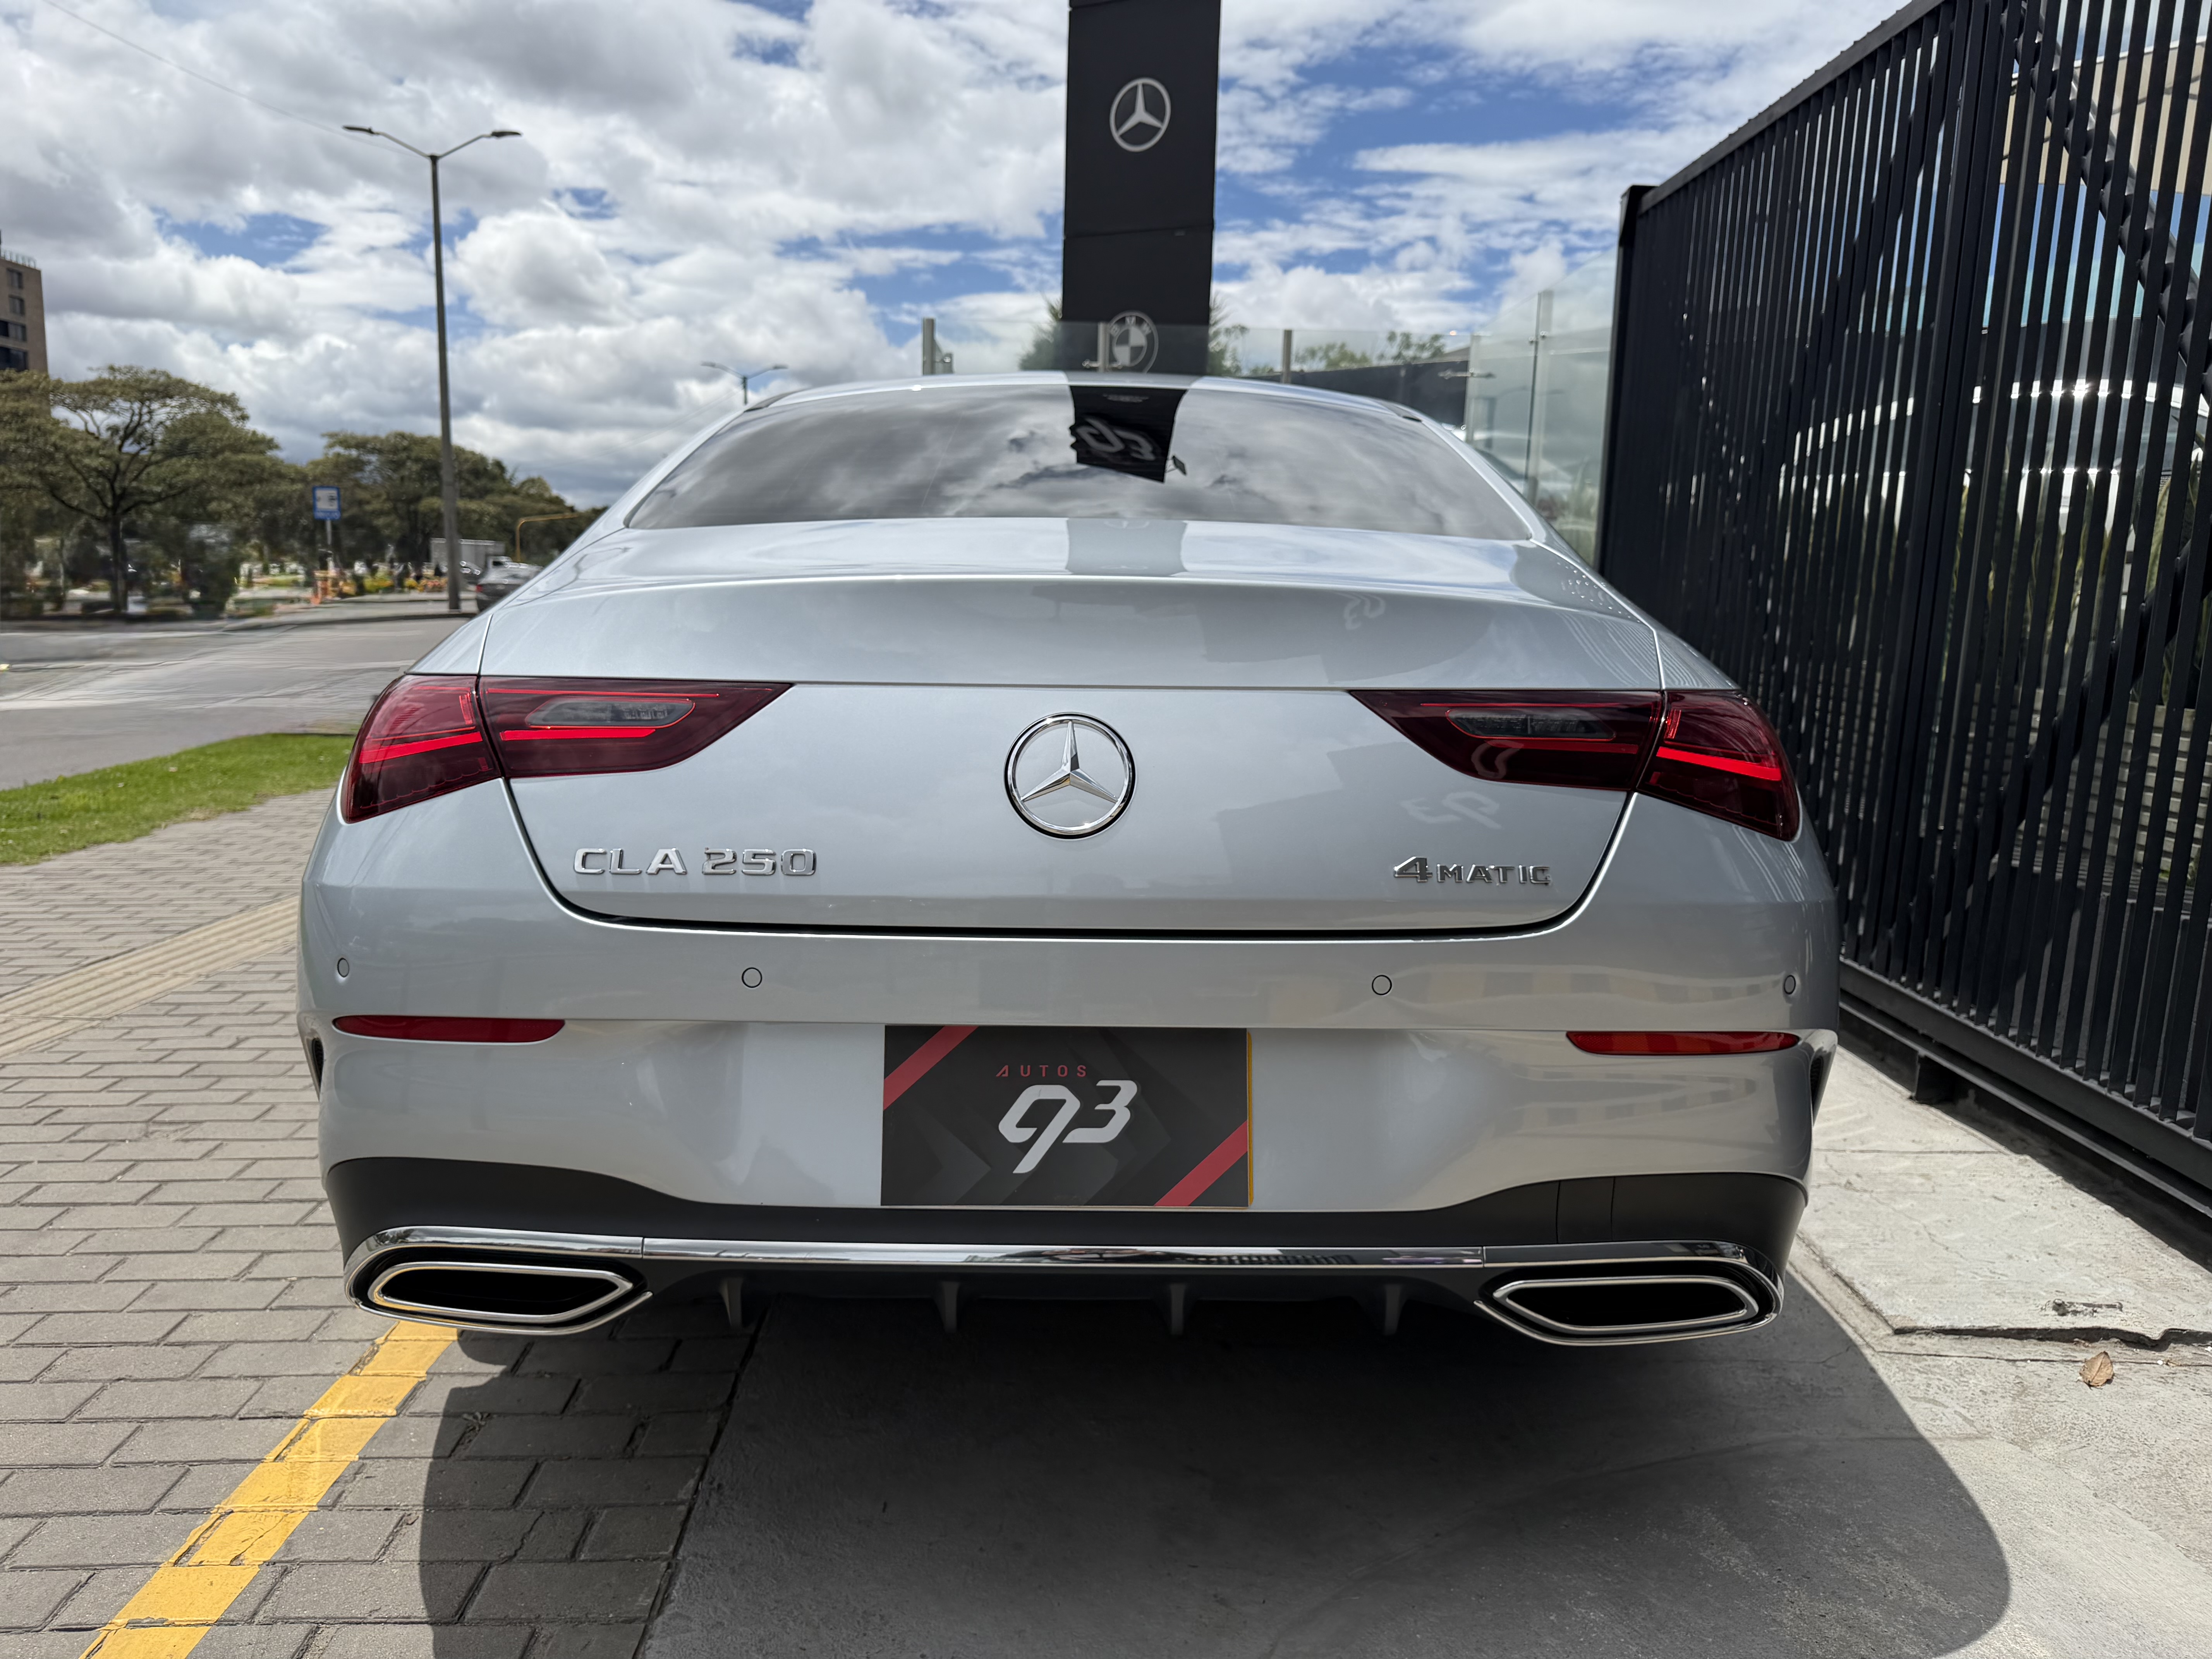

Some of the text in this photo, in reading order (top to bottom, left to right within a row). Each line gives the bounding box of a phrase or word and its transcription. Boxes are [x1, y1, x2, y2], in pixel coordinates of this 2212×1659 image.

[574, 848, 817, 876] CLA 250
[996, 1065, 1087, 1077] AUTOS
[998, 1079, 1138, 1174] 93
